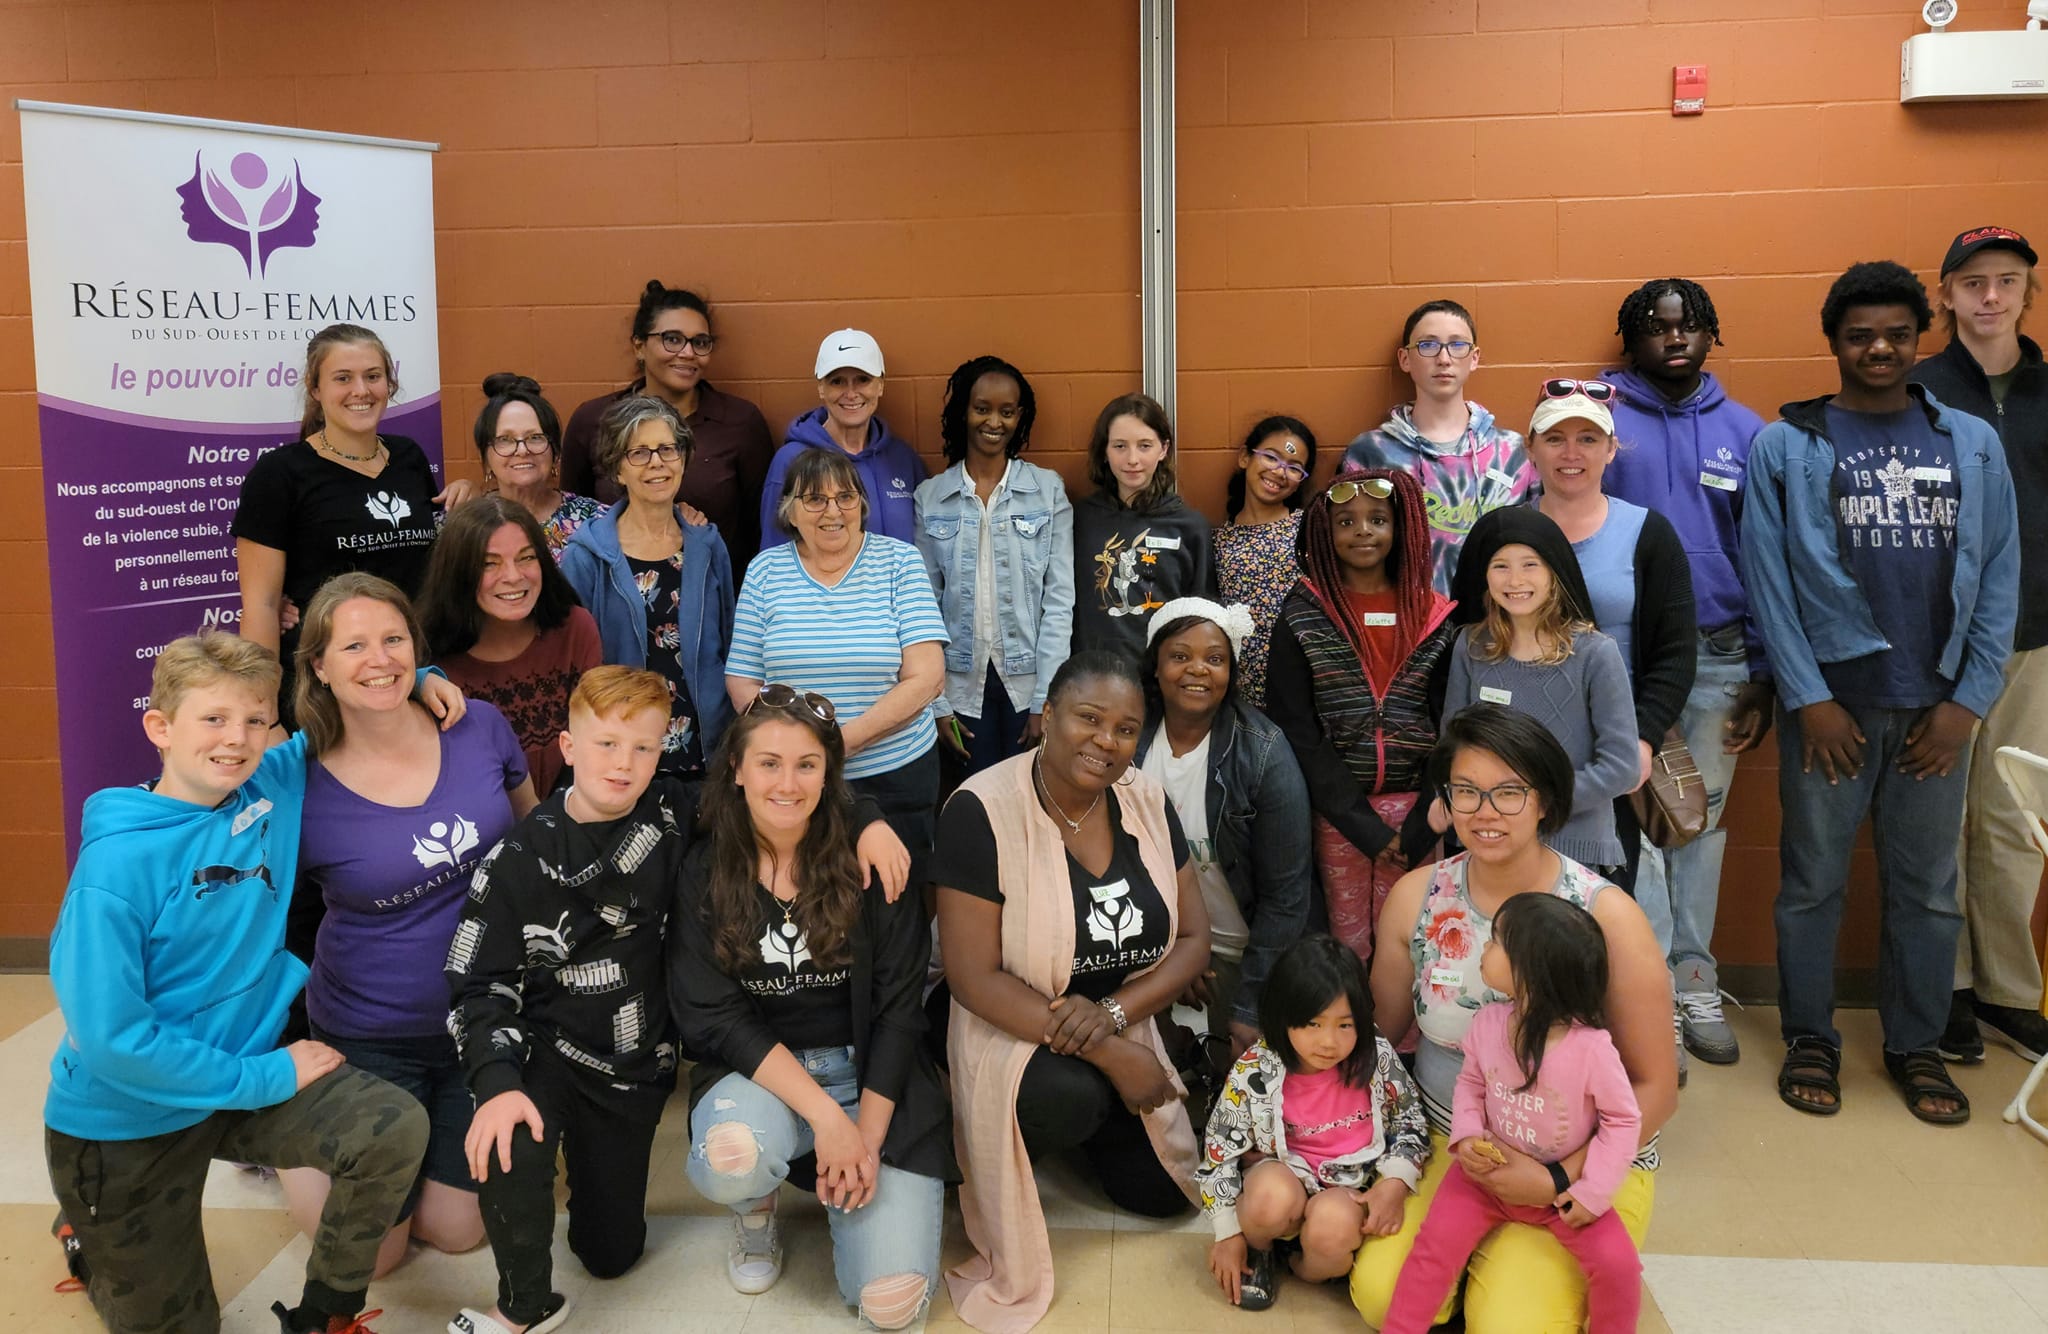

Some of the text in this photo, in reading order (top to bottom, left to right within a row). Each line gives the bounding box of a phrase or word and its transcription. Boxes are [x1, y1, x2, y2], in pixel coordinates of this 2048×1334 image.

[69, 281, 417, 322] RÉSEAU-FEMMES
[131, 329, 155, 341] DU
[163, 328, 260, 341] SUD-OUEST
[268, 329, 286, 341] DE
[111, 361, 299, 397] le pouvoir de
[188, 445, 250, 465] Notre
[1838, 446, 1921, 471] PROPERTY
[57, 482, 98, 497] Nous
[101, 477, 206, 494] accompagnons
[209, 474, 223, 488] et
[1853, 470, 1873, 489] 19
[95, 506, 114, 521] du
[118, 500, 186, 518] sud-ouest
[189, 499, 206, 513] de
[82, 533, 101, 546] de
[105, 531, 118, 545] la
[122, 527, 179, 544] violence
[182, 523, 223, 539] subie,
[1852, 528, 1953, 548] HOCKEY
[115, 546, 228, 572] personnellement
[139, 577, 148, 592] à
[152, 578, 169, 590] un
[173, 572, 218, 588] réseau
[558, 961, 625, 991] PUMA
[1496, 1113, 1537, 1145] YEAR
